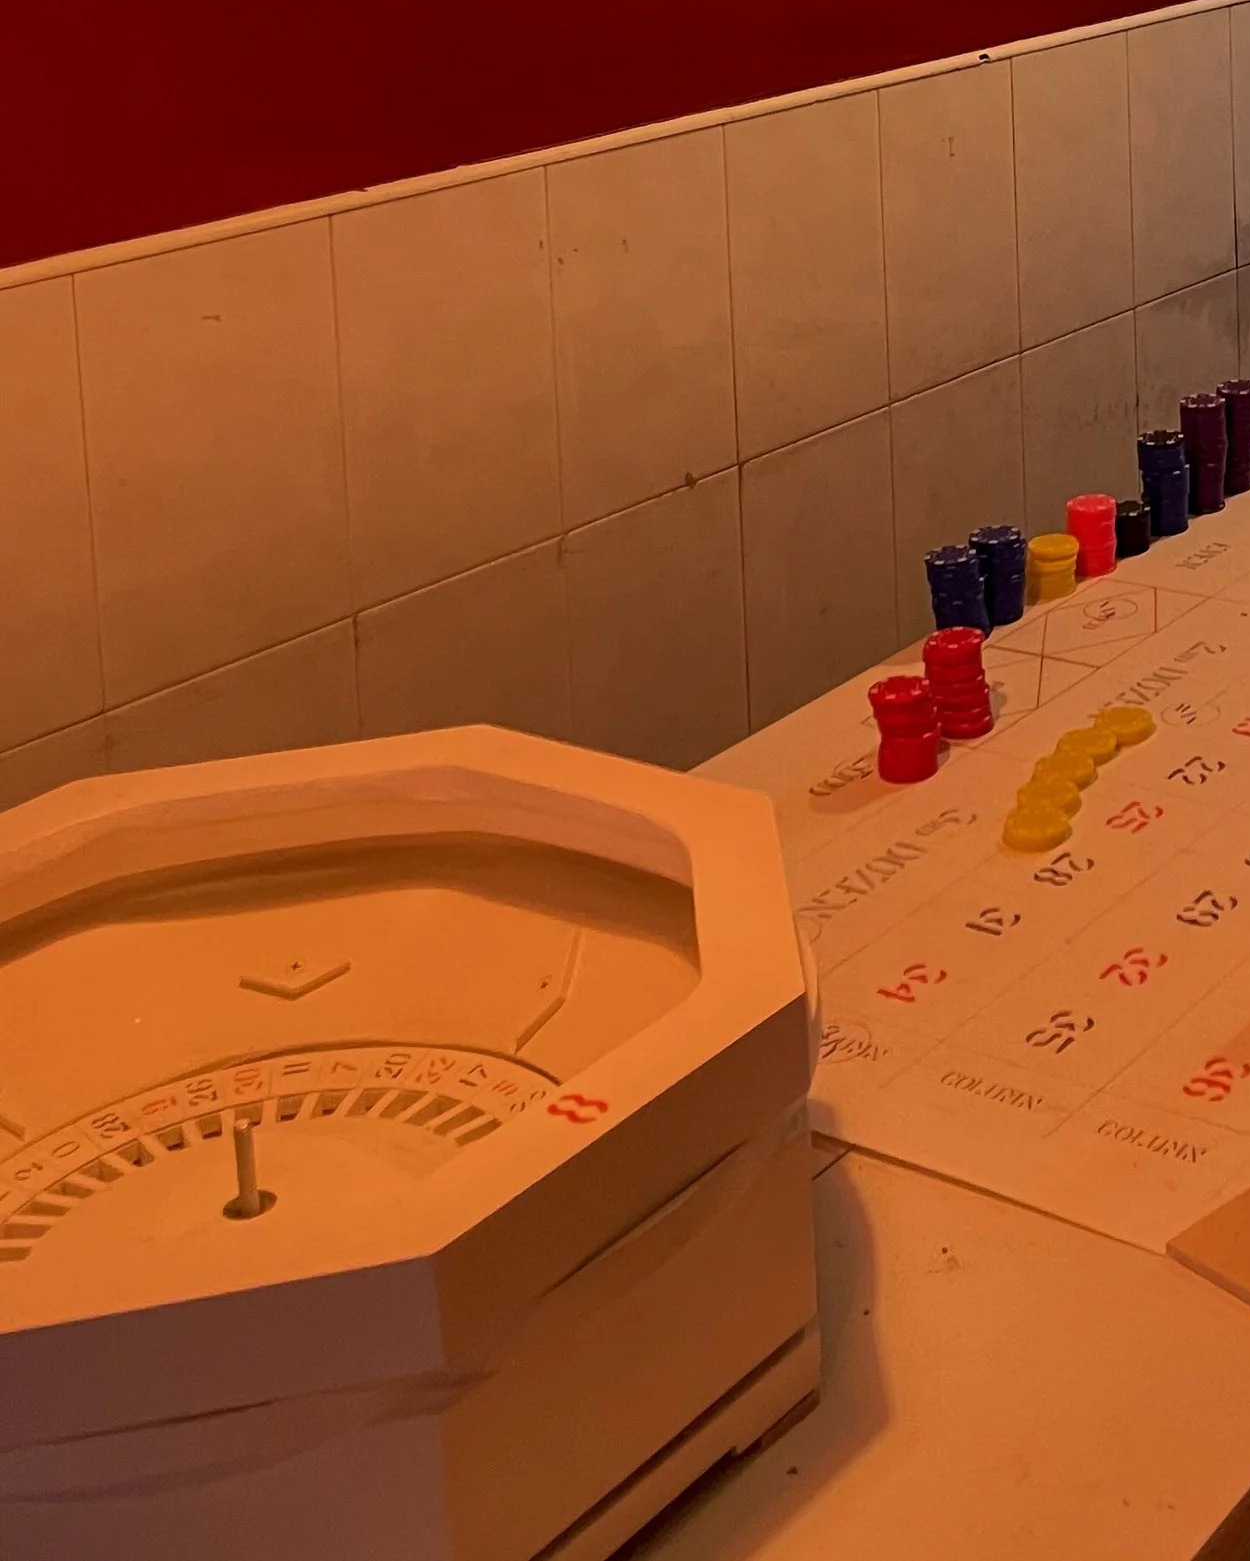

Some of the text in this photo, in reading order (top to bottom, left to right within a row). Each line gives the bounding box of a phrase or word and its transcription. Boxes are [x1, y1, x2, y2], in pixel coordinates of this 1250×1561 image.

[1092, 666, 1189, 715] DOZE
[1168, 755, 1226, 785] 22
[1106, 801, 1164, 834] 25
[1034, 852, 1094, 886] 28
[965, 907, 1021, 936] 31
[1176, 890, 1238, 927] 29
[876, 963, 947, 1003] 34
[1099, 947, 1168, 986] 32
[1025, 1010, 1095, 1054] 35
[940, 1071, 1043, 1111] COLUMN
[1097, 1119, 1207, 1162] COLUMN
